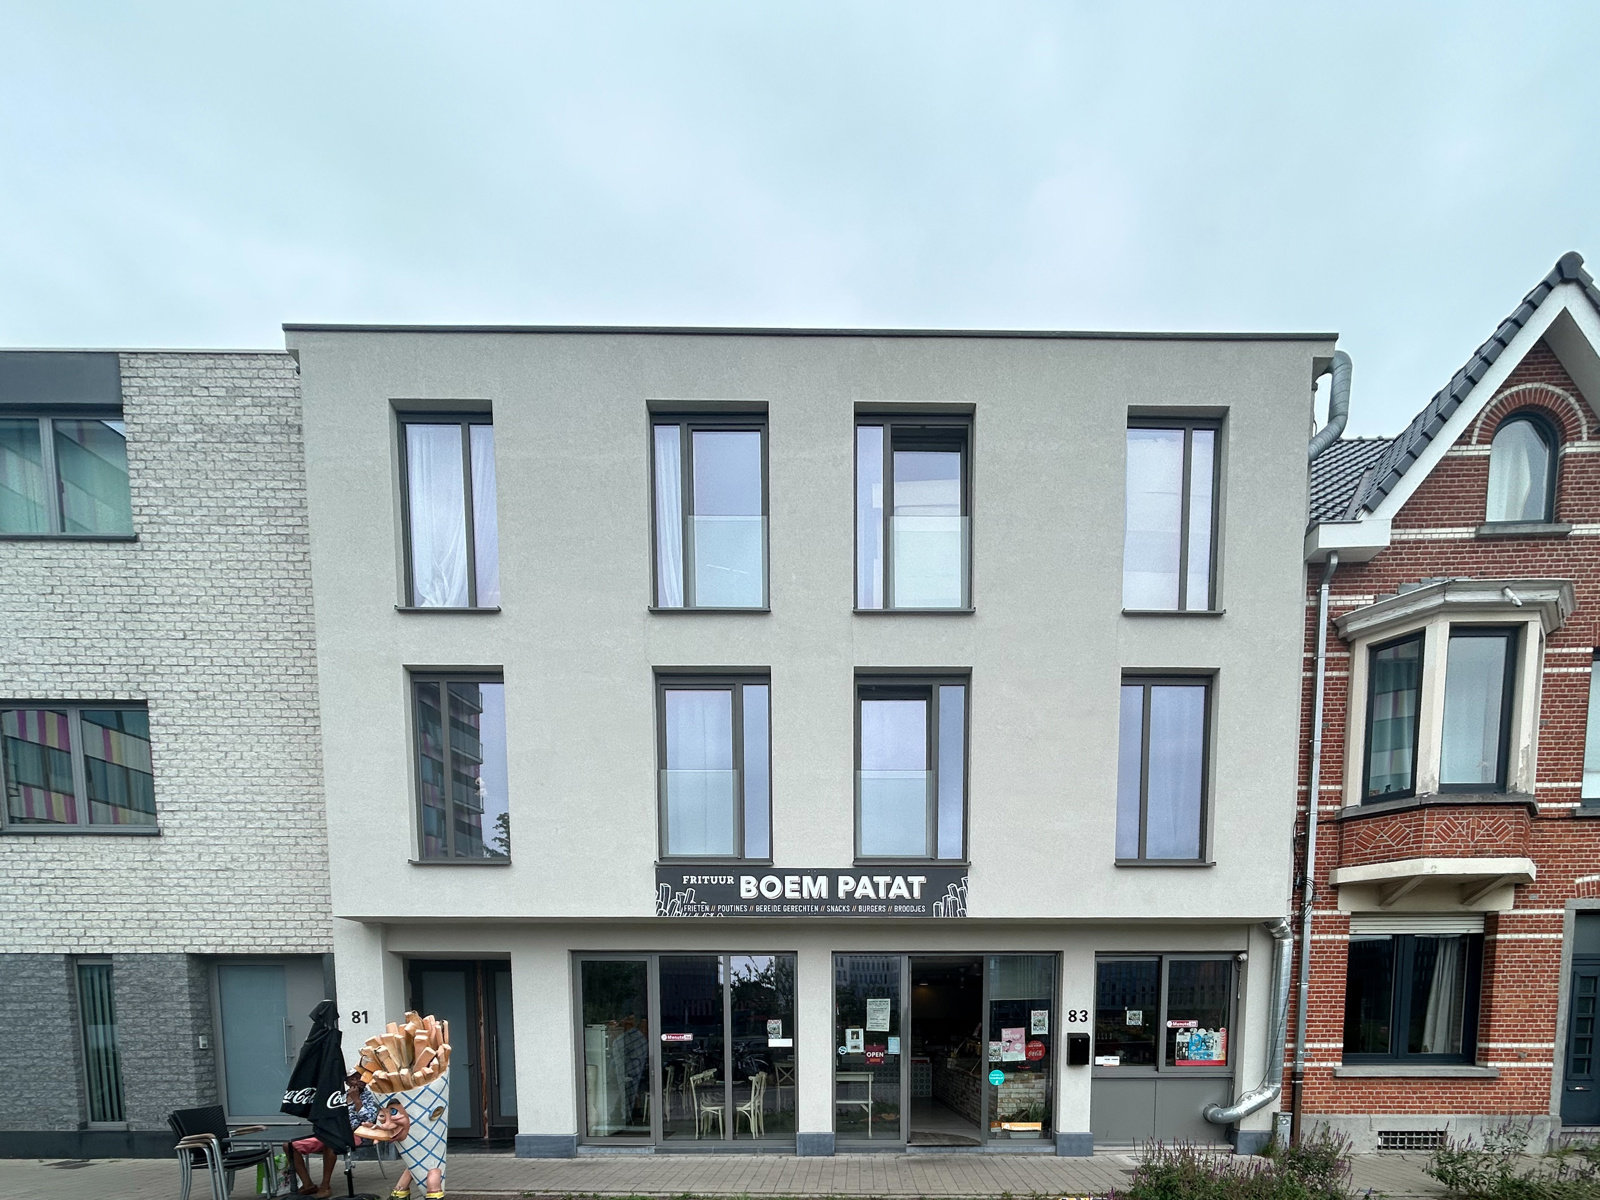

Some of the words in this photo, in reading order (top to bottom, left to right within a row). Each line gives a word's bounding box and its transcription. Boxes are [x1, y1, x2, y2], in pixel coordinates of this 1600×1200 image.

[682, 875, 735, 885] FRITUUR
[739, 875, 829, 900] BOEM
[837, 875, 927, 900] PATAT
[683, 904, 710, 912] FRIETEN
[717, 904, 748, 912] POUTINES
[755, 904, 782, 912] BEREIDE
[782, 904, 819, 912] GERECHTEN
[826, 904, 851, 913] SNACKS
[858, 904, 886, 913] BURGERS
[893, 904, 926, 913] BROODJES
[351, 1010, 369, 1024] 81
[1068, 1009, 1088, 1023] 83
